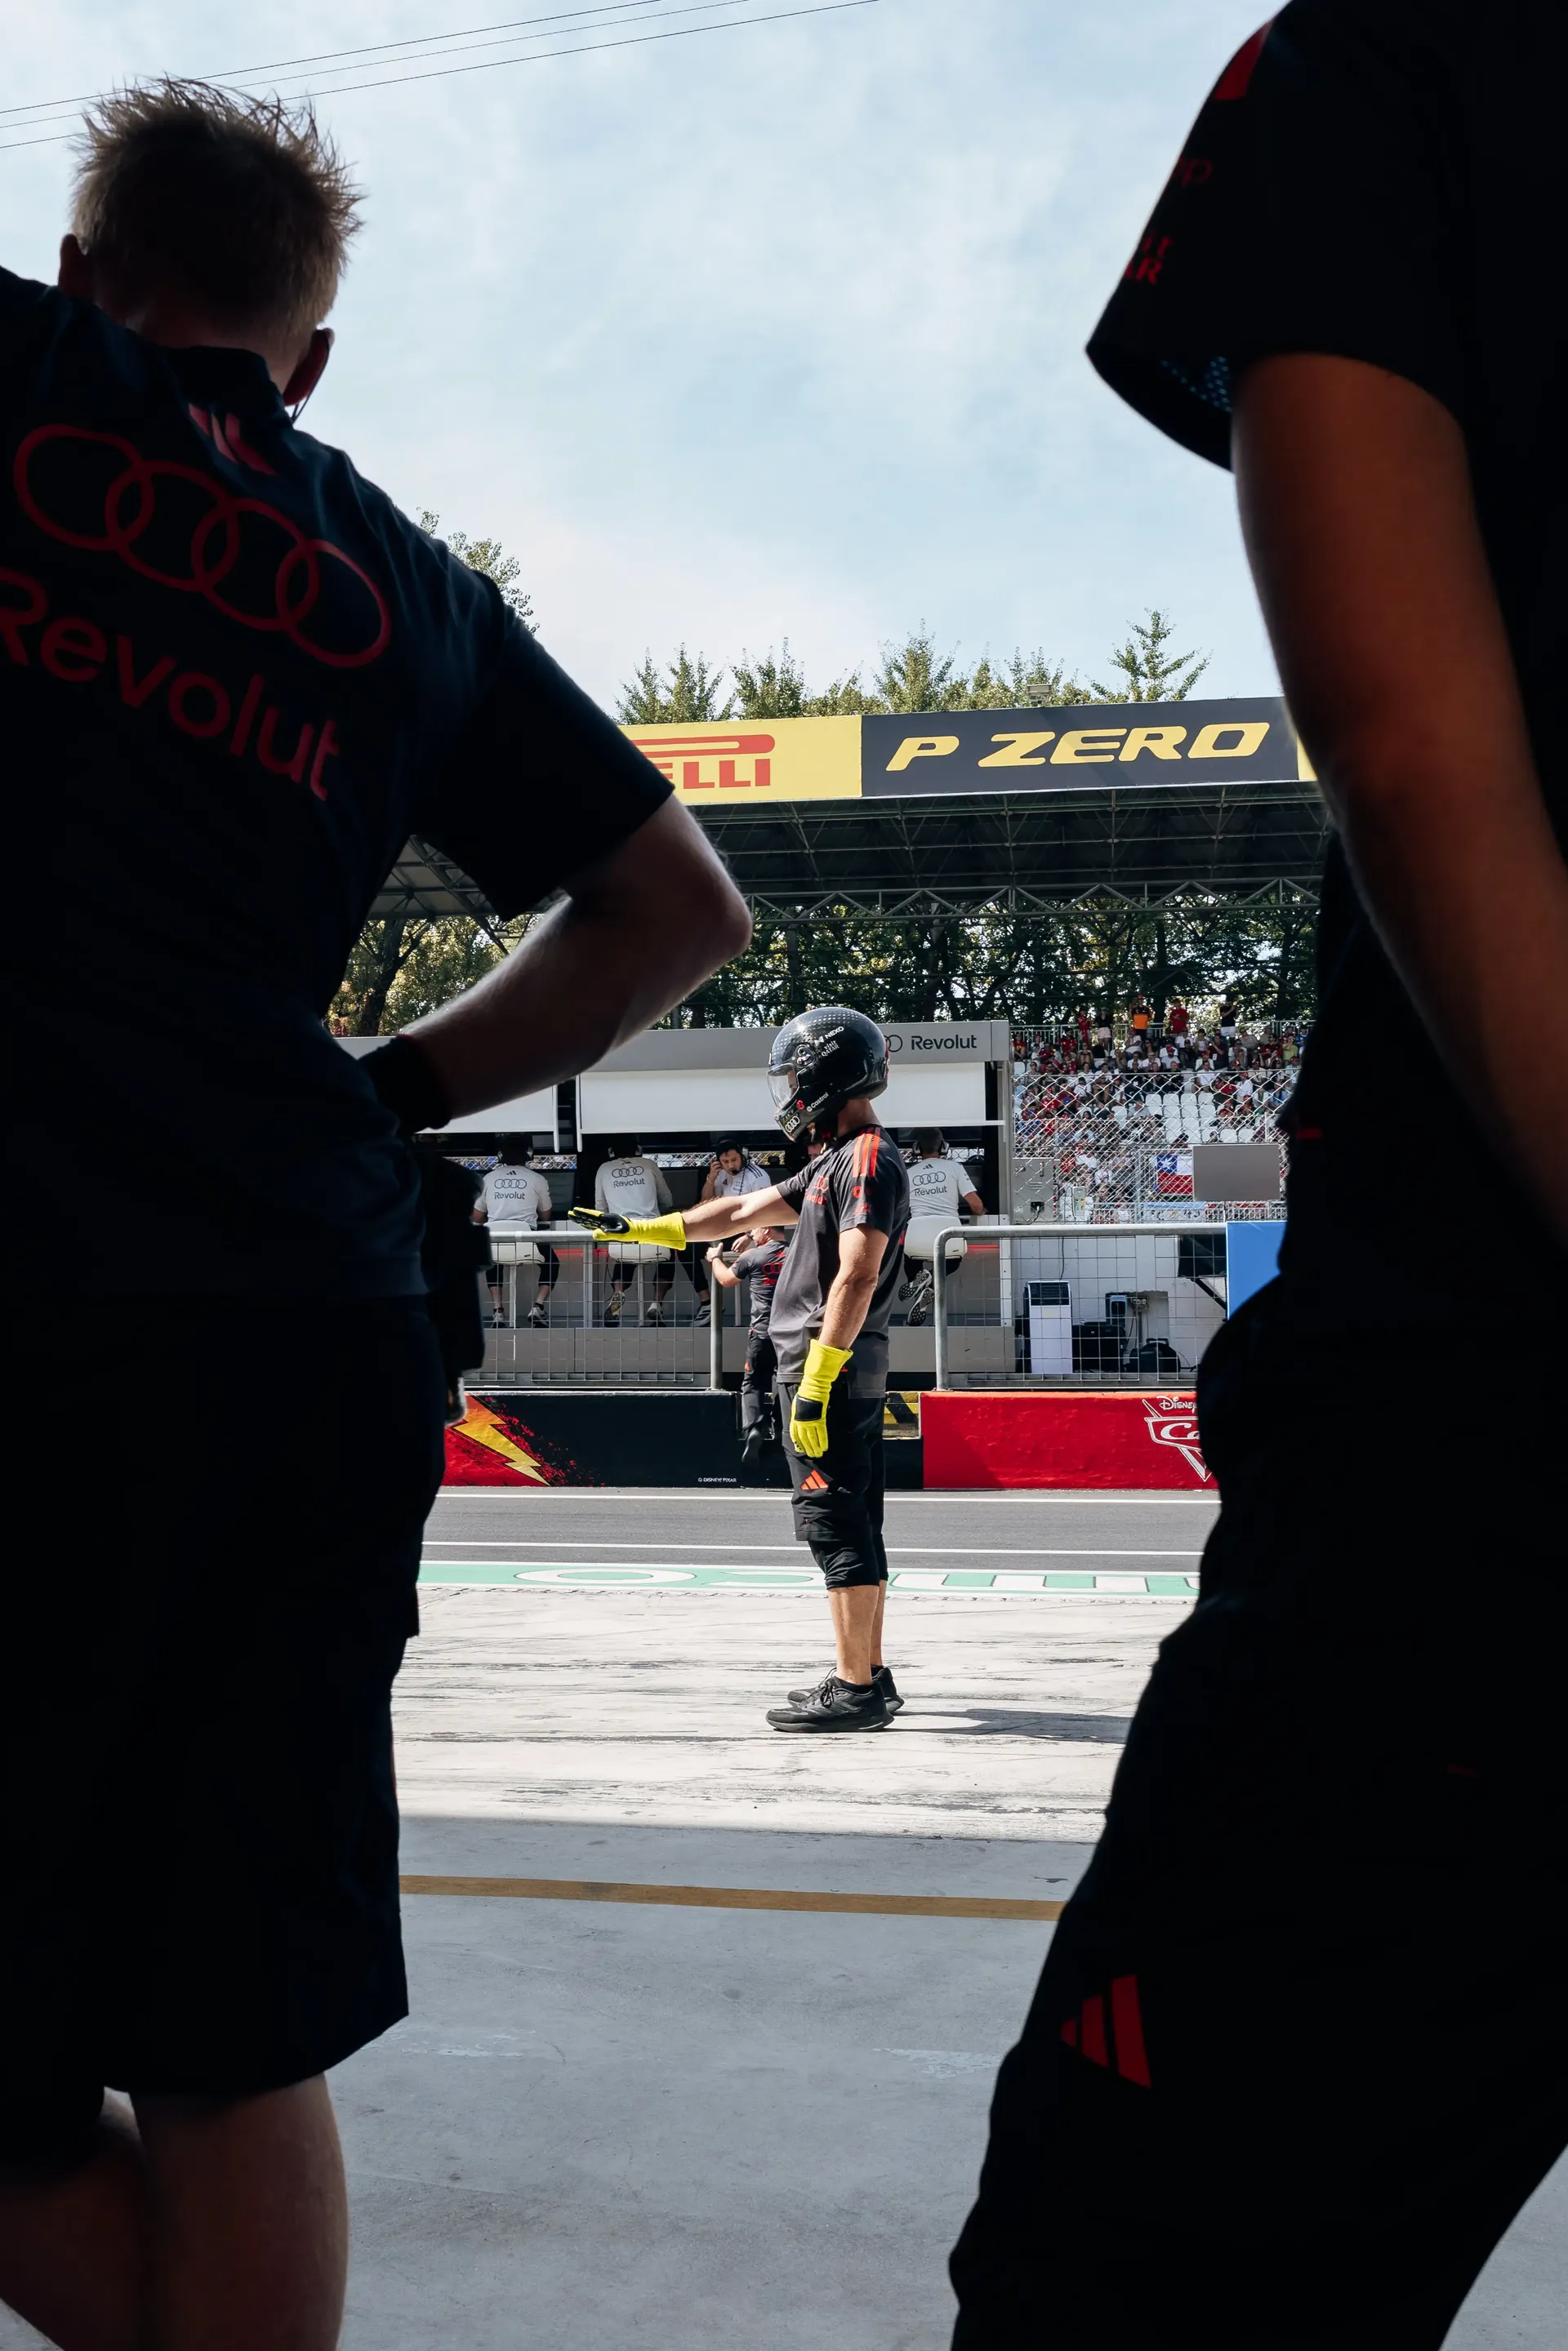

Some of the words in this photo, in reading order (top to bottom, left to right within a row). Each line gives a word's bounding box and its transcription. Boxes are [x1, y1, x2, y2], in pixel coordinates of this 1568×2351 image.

[0, 565, 340, 801] Revolut
[886, 736, 960, 771] P
[978, 722, 1270, 768] ZERO
[825, 1026, 844, 1040] NEXO
[911, 1035, 977, 1050] Revolut
[821, 1044, 840, 1057] QATAR
[811, 1093, 829, 1108] Castrol
[613, 1178, 646, 1189] Revolut
[494, 1191, 525, 1200] Revolut
[915, 1186, 947, 1196] Revolut
